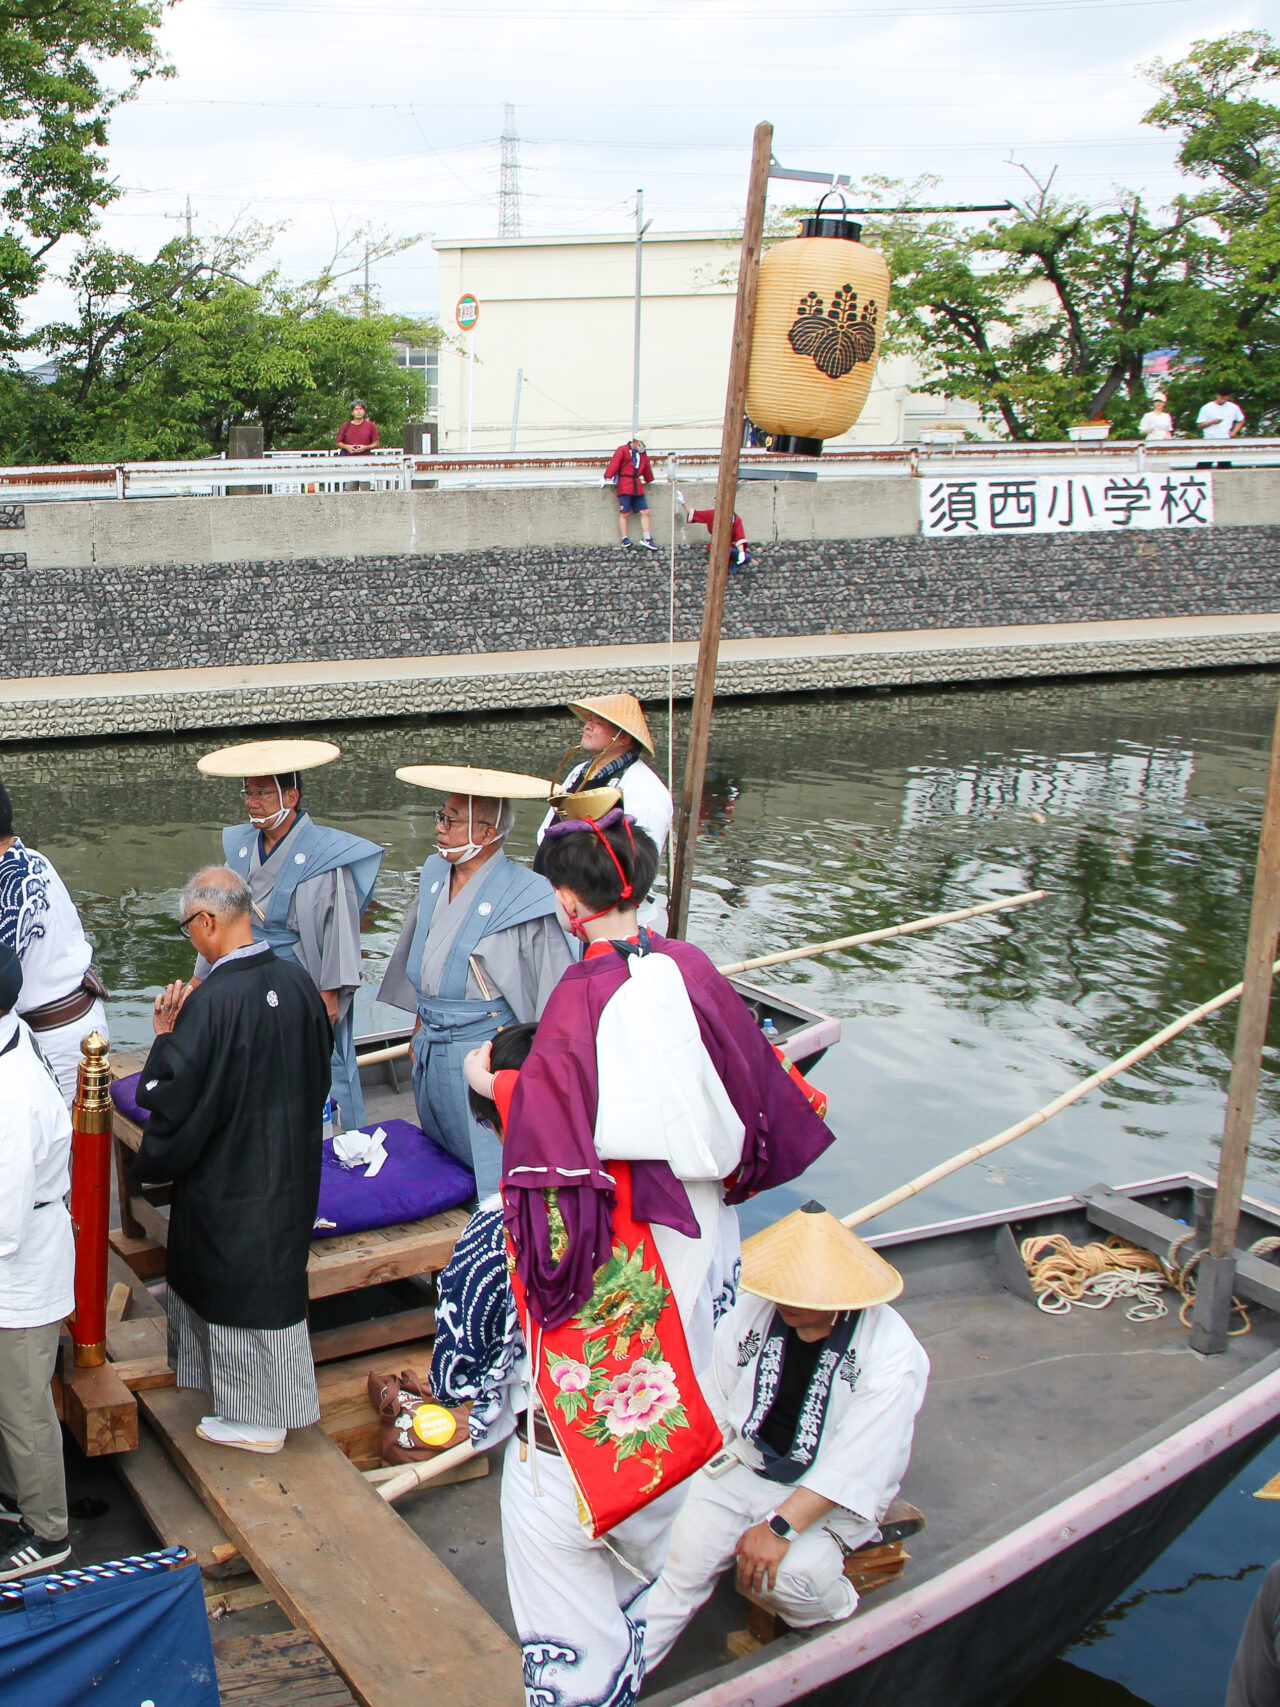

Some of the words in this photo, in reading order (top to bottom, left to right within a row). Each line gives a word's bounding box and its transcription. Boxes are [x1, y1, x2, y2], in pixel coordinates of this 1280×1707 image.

[929, 475, 1209, 533] 須西小学校
